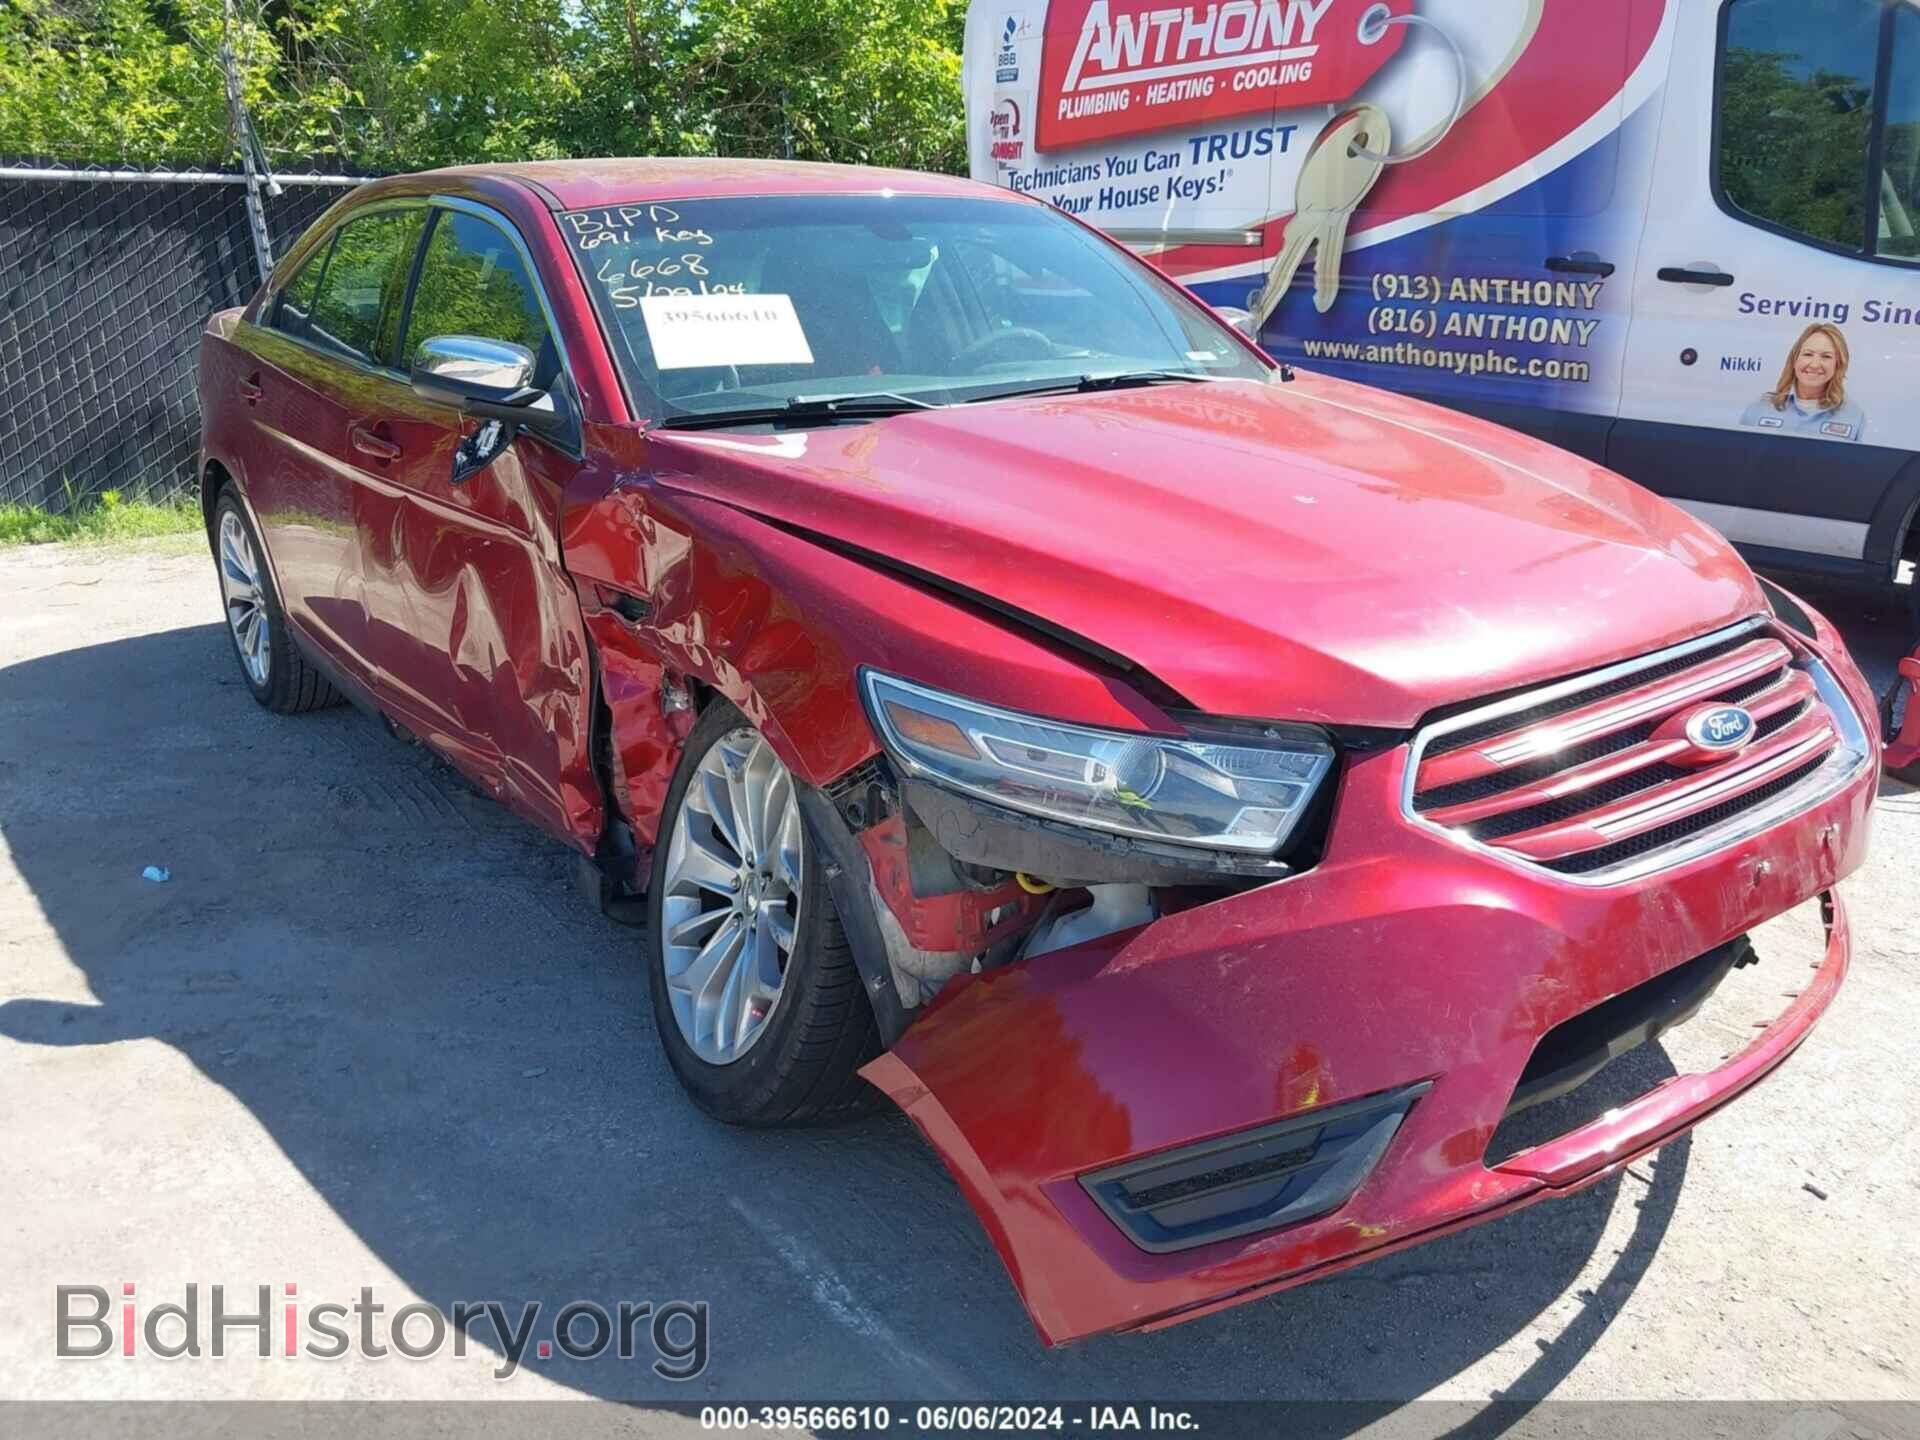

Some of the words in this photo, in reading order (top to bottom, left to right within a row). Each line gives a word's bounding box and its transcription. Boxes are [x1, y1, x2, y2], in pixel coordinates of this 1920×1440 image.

[1062, 0, 1334, 92] ANTHONY
[1058, 88, 1130, 120] PLUMBING
[1145, 76, 1214, 106] HEATING
[1232, 61, 1312, 91] COOLING
[1008, 160, 1100, 192] Technicians
[1105, 156, 1138, 178] You
[1143, 151, 1180, 173] Can
[1189, 125, 1298, 165] TRUST
[1100, 184, 1159, 210] House
[1372, 273, 1441, 304] (913)
[1449, 277, 1603, 309] ANTHONY
[1738, 292, 1849, 324] Serving
[1368, 306, 1437, 338] (816)
[1443, 311, 1600, 347] ANTHONY
[1303, 339, 1589, 381] www.anthonyphc.com
[1720, 357, 1762, 371] Nikki
[1708, 713, 1744, 740] Ford
